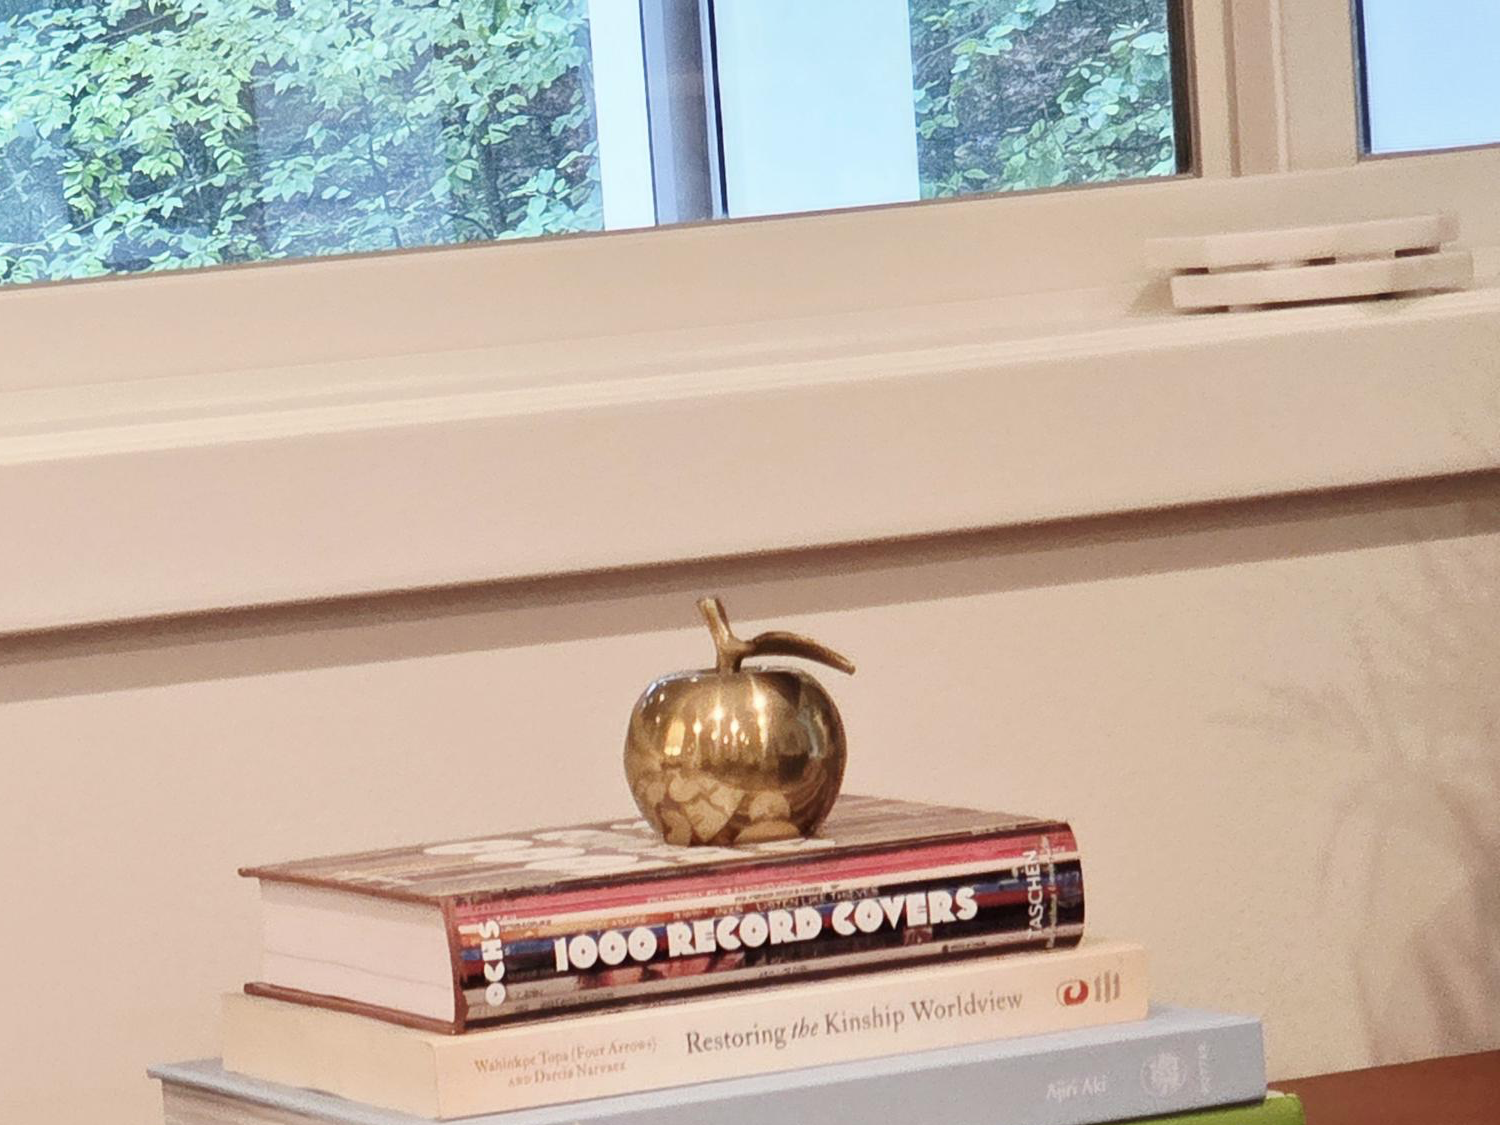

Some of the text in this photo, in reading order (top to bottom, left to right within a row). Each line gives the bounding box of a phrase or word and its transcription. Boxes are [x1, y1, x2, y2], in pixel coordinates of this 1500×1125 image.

[554, 927, 657, 972] 1000
[666, 907, 823, 958] RECORD
[832, 887, 978, 936] COVERS
[1022, 850, 1044, 940] TASCHEN
[478, 919, 507, 1007] OCHS
[686, 992, 1024, 1055] Restoring the Kinship Worldview
